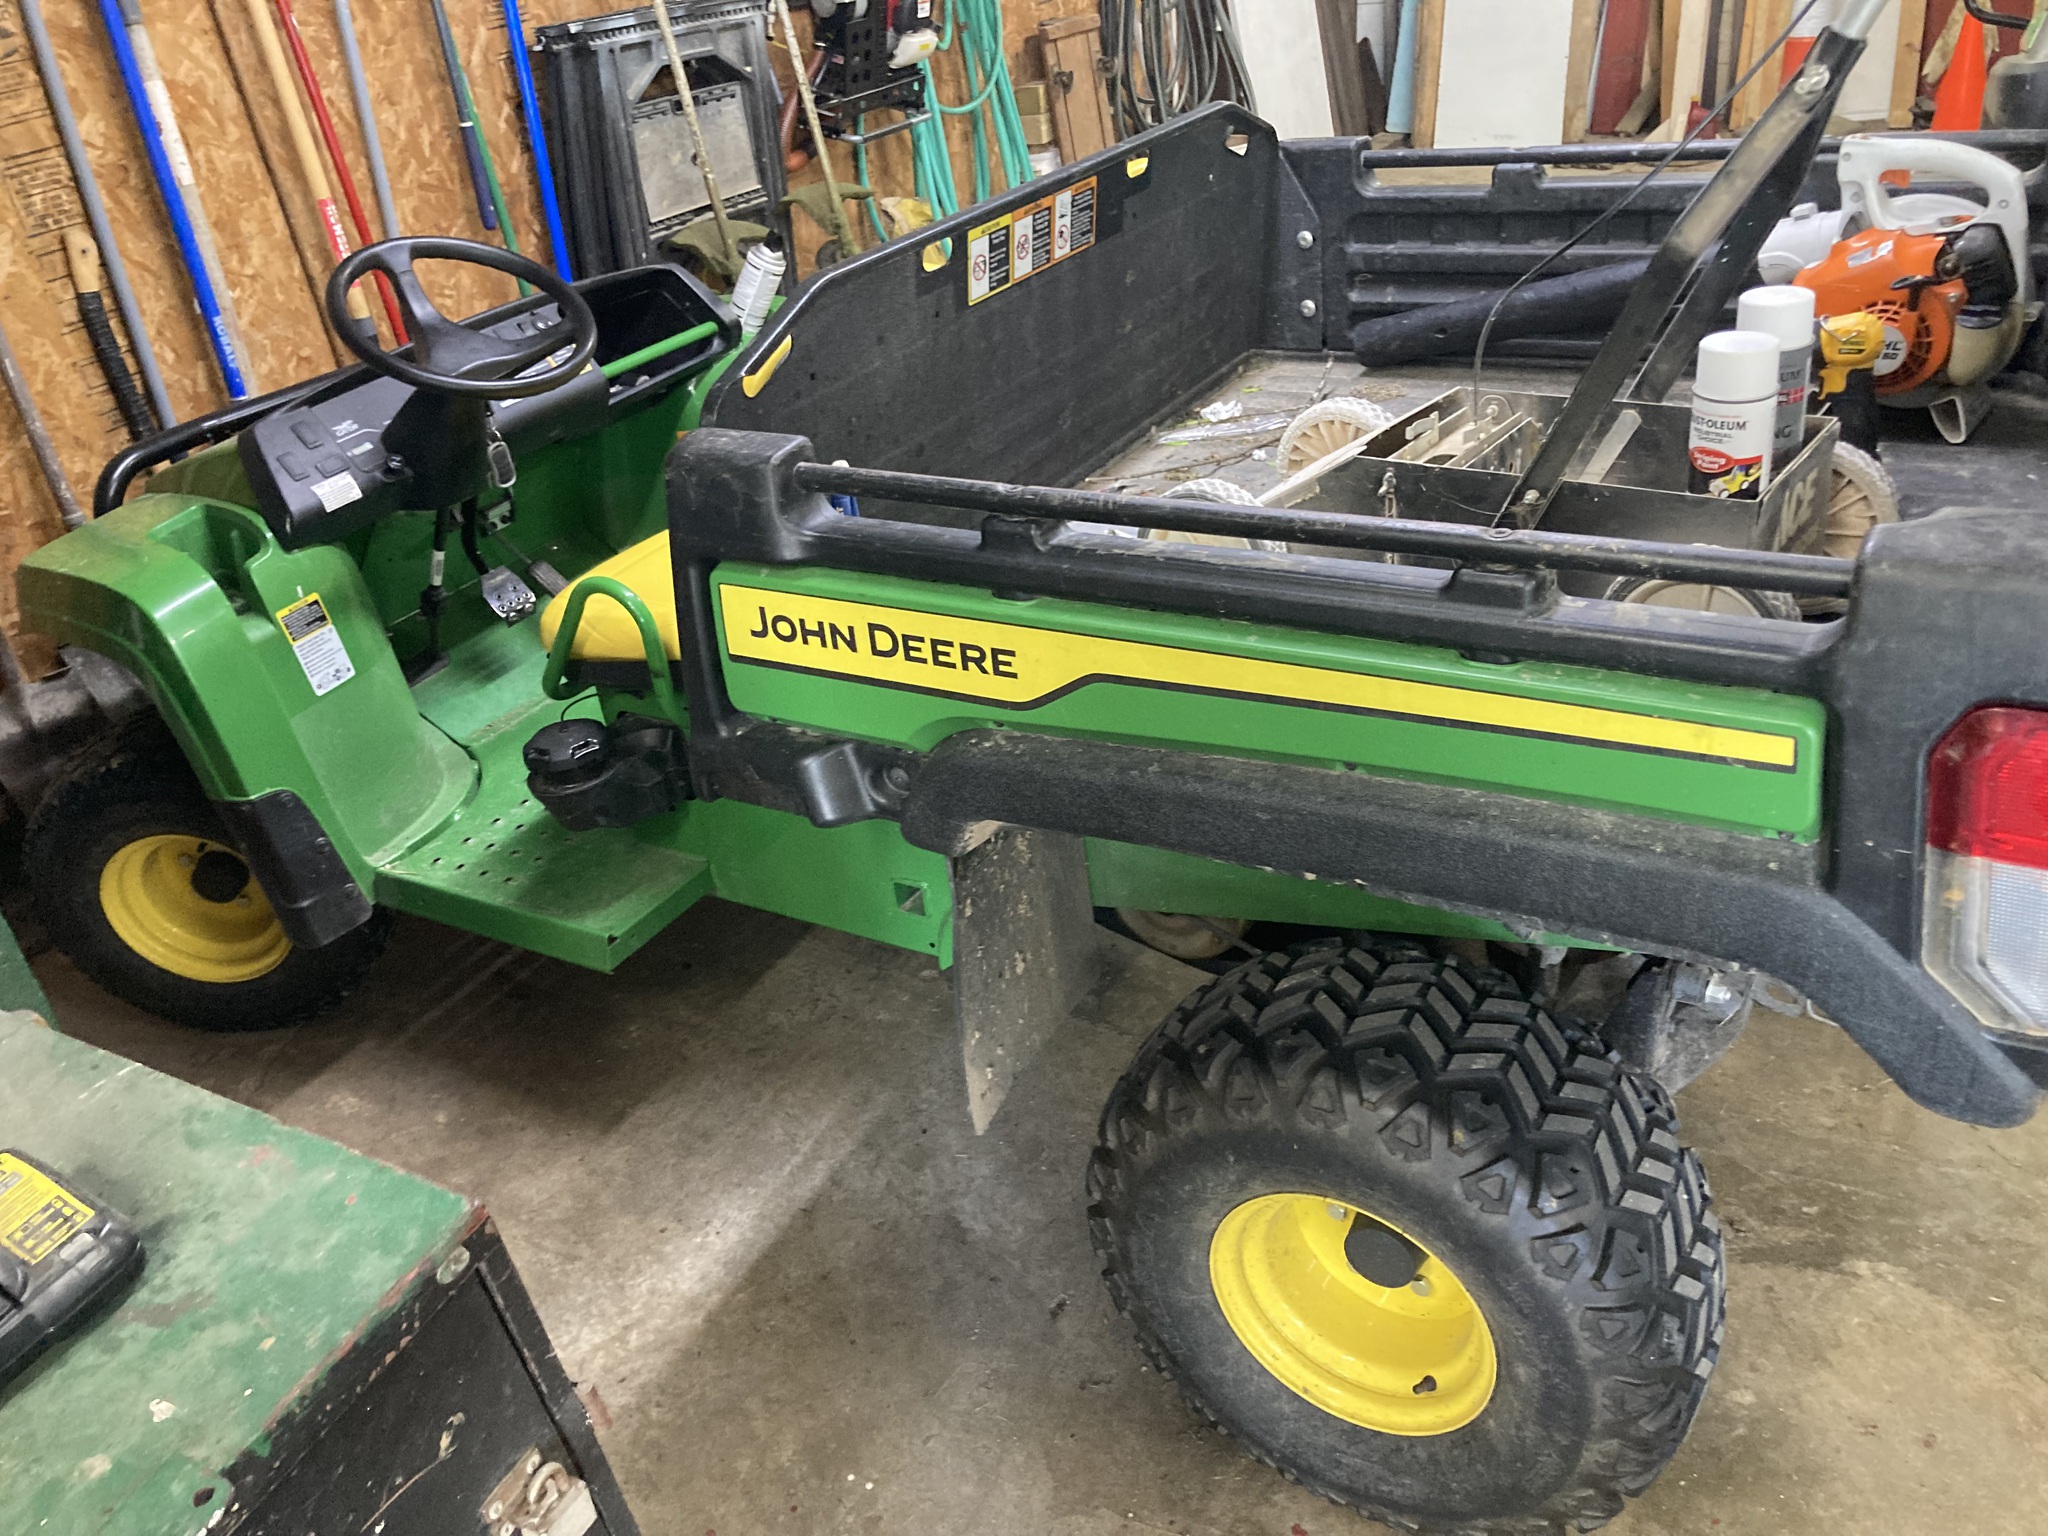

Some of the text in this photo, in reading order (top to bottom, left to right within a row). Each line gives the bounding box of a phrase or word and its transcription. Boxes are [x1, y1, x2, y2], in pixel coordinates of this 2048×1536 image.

[212, 315, 238, 369] KOBALT
[1692, 416, 1747, 431] ST-OLEUM
[750, 606, 1018, 679] JOHN DEERE
